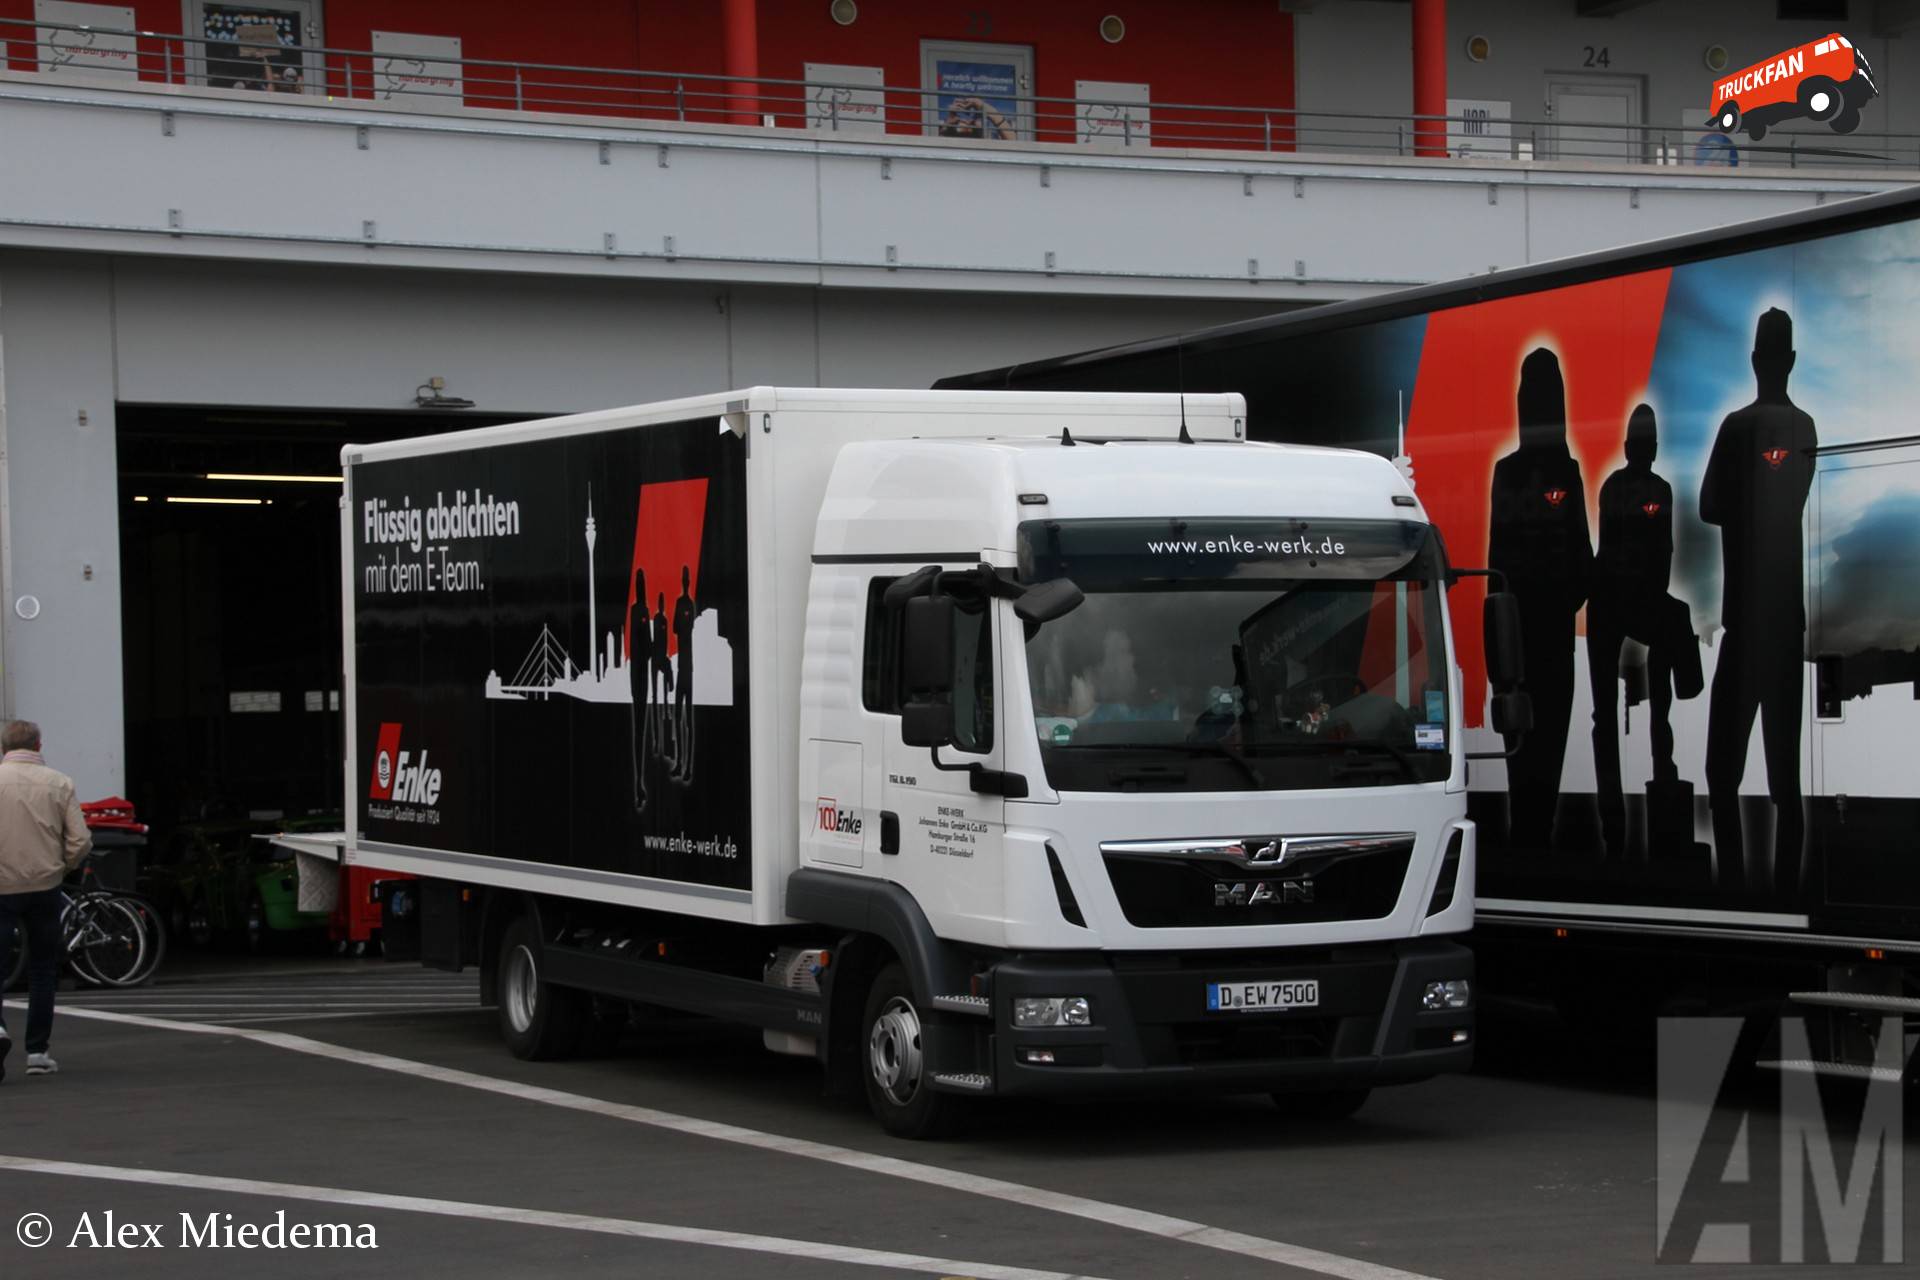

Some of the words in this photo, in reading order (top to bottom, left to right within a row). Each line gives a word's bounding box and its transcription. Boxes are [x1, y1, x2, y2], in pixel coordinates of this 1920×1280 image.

[1583, 46, 1611, 68] 24
[364, 496, 422, 553] Flüssig
[426, 488, 520, 540] abdichten
[1147, 534, 1345, 555] www.enke-werk.de
[365, 553, 387, 593] mit
[390, 546, 422, 593] dem
[426, 546, 484, 592] E-Team.
[392, 749, 442, 806] Enke
[643, 830, 738, 859] www.enke-werk.de
[1214, 880, 1314, 906] MAN
[1220, 986, 1232, 1007] D
[796, 1009, 823, 1025] MAN
